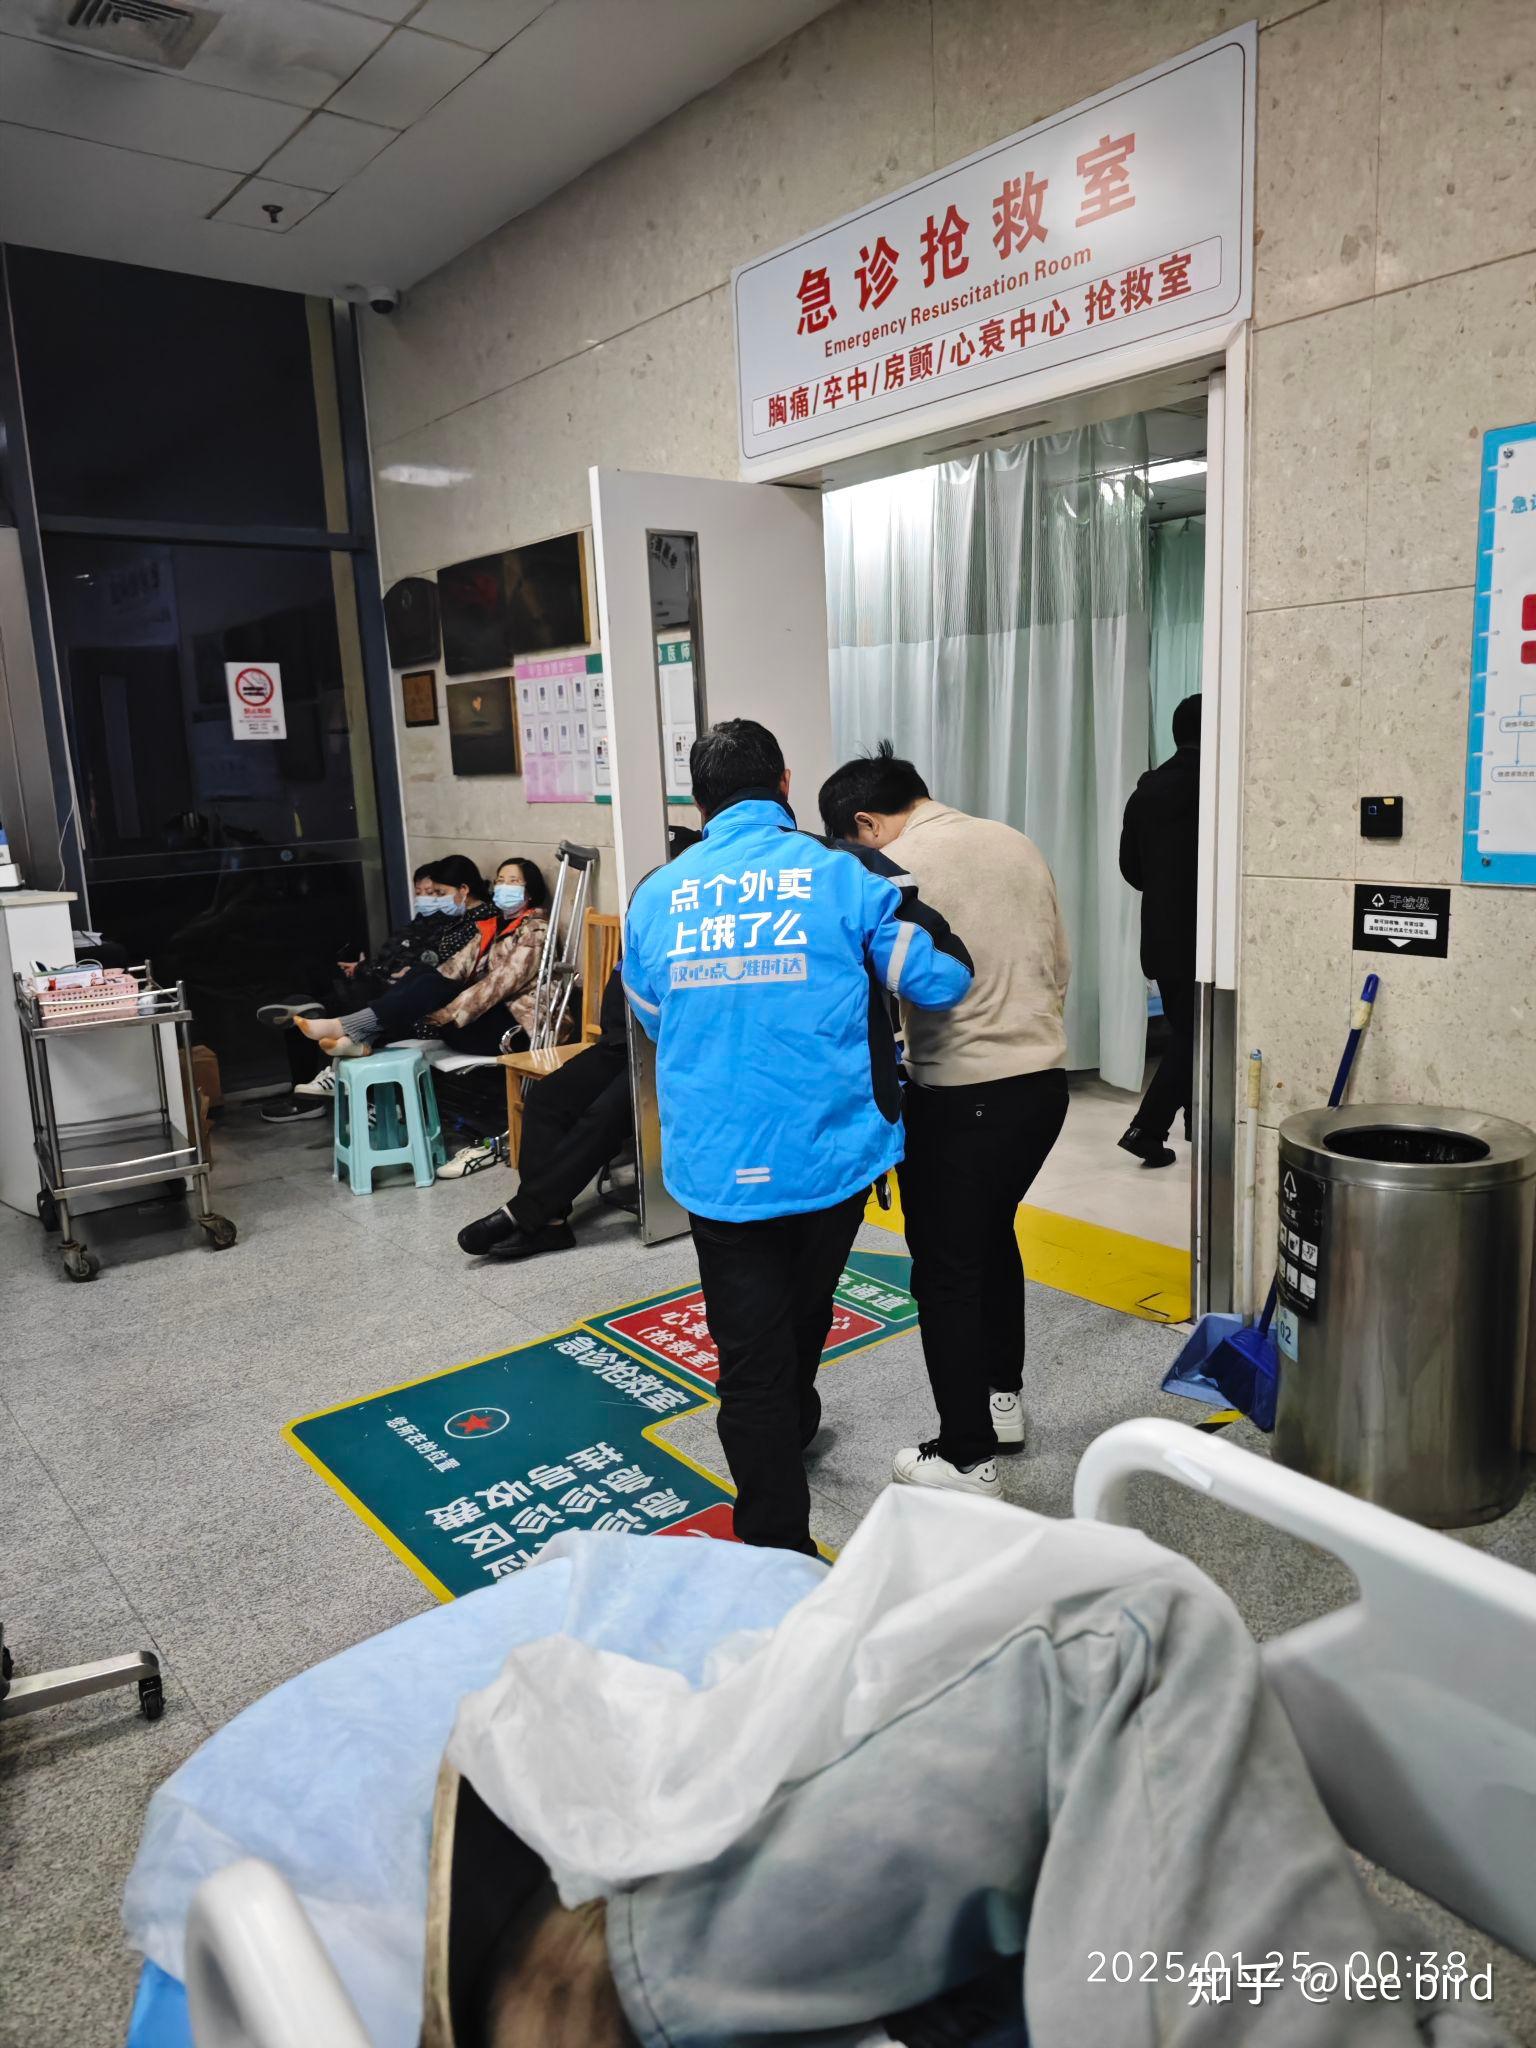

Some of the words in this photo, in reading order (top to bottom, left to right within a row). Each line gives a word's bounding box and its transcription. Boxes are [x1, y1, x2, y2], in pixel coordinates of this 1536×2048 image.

[796, 133, 1137, 336] 急诊抢救室
[768, 299, 1072, 428] 胸痛/卒中/房颤/心衰中心
[1085, 253, 1194, 326] 抢救室
[824, 315, 908, 358] Emergency
[910, 270, 1030, 327] Resuscitation
[1034, 247, 1093, 282] Room
[666, 909, 808, 958] 上饿了么
[669, 868, 813, 915] 点个外卖
[554, 1336, 691, 1413] 急诊抢救室
[385, 1416, 461, 1473] 您所在的位置
[425, 1441, 624, 1531] 挂号收费
[452, 1464, 655, 1560] 急诊诊区
[482, 1487, 691, 1580] 急诊检
